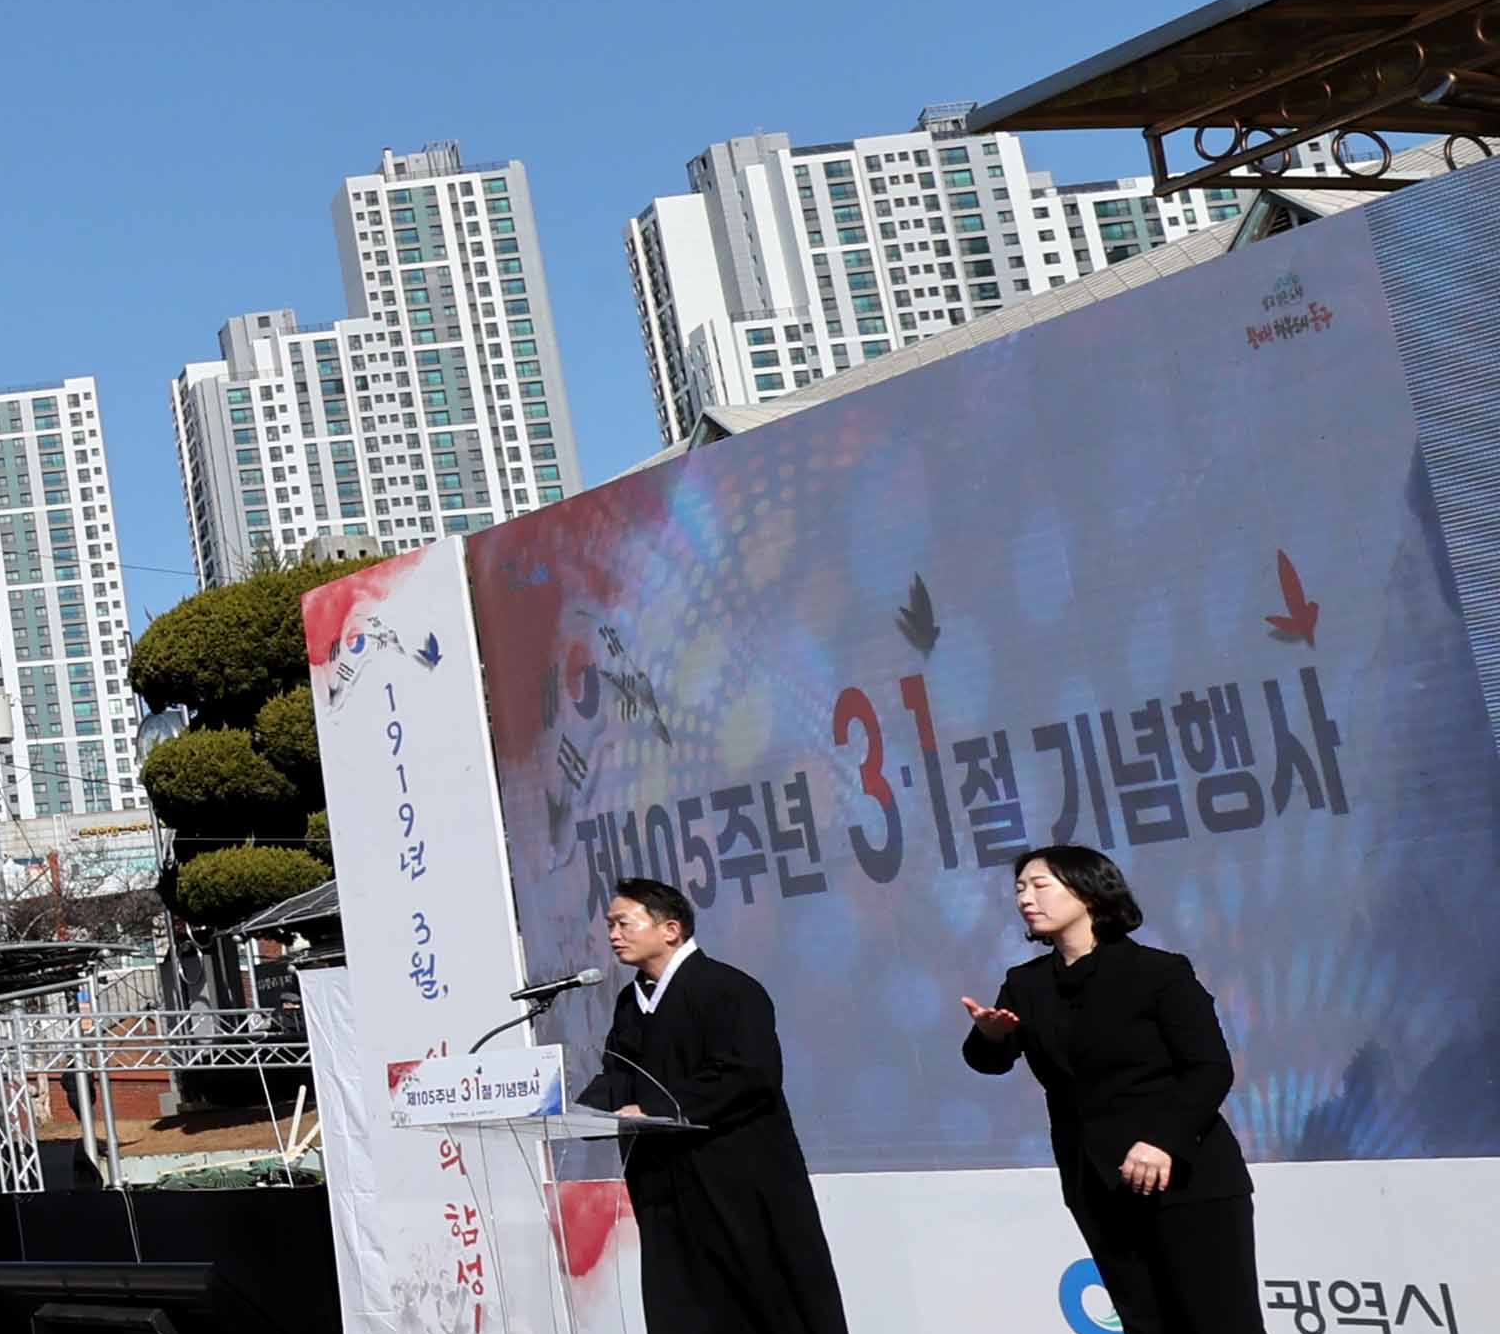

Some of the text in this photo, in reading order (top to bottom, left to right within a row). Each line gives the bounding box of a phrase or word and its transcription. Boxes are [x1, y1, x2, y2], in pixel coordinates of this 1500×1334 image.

[385, 683, 426, 880] 1919년
[576, 770, 827, 923] 제105주년
[1033, 667, 1349, 851] 기념행사
[406, 1087, 456, 1106] 제105주년
[495, 1080, 540, 1098] 기념행사
